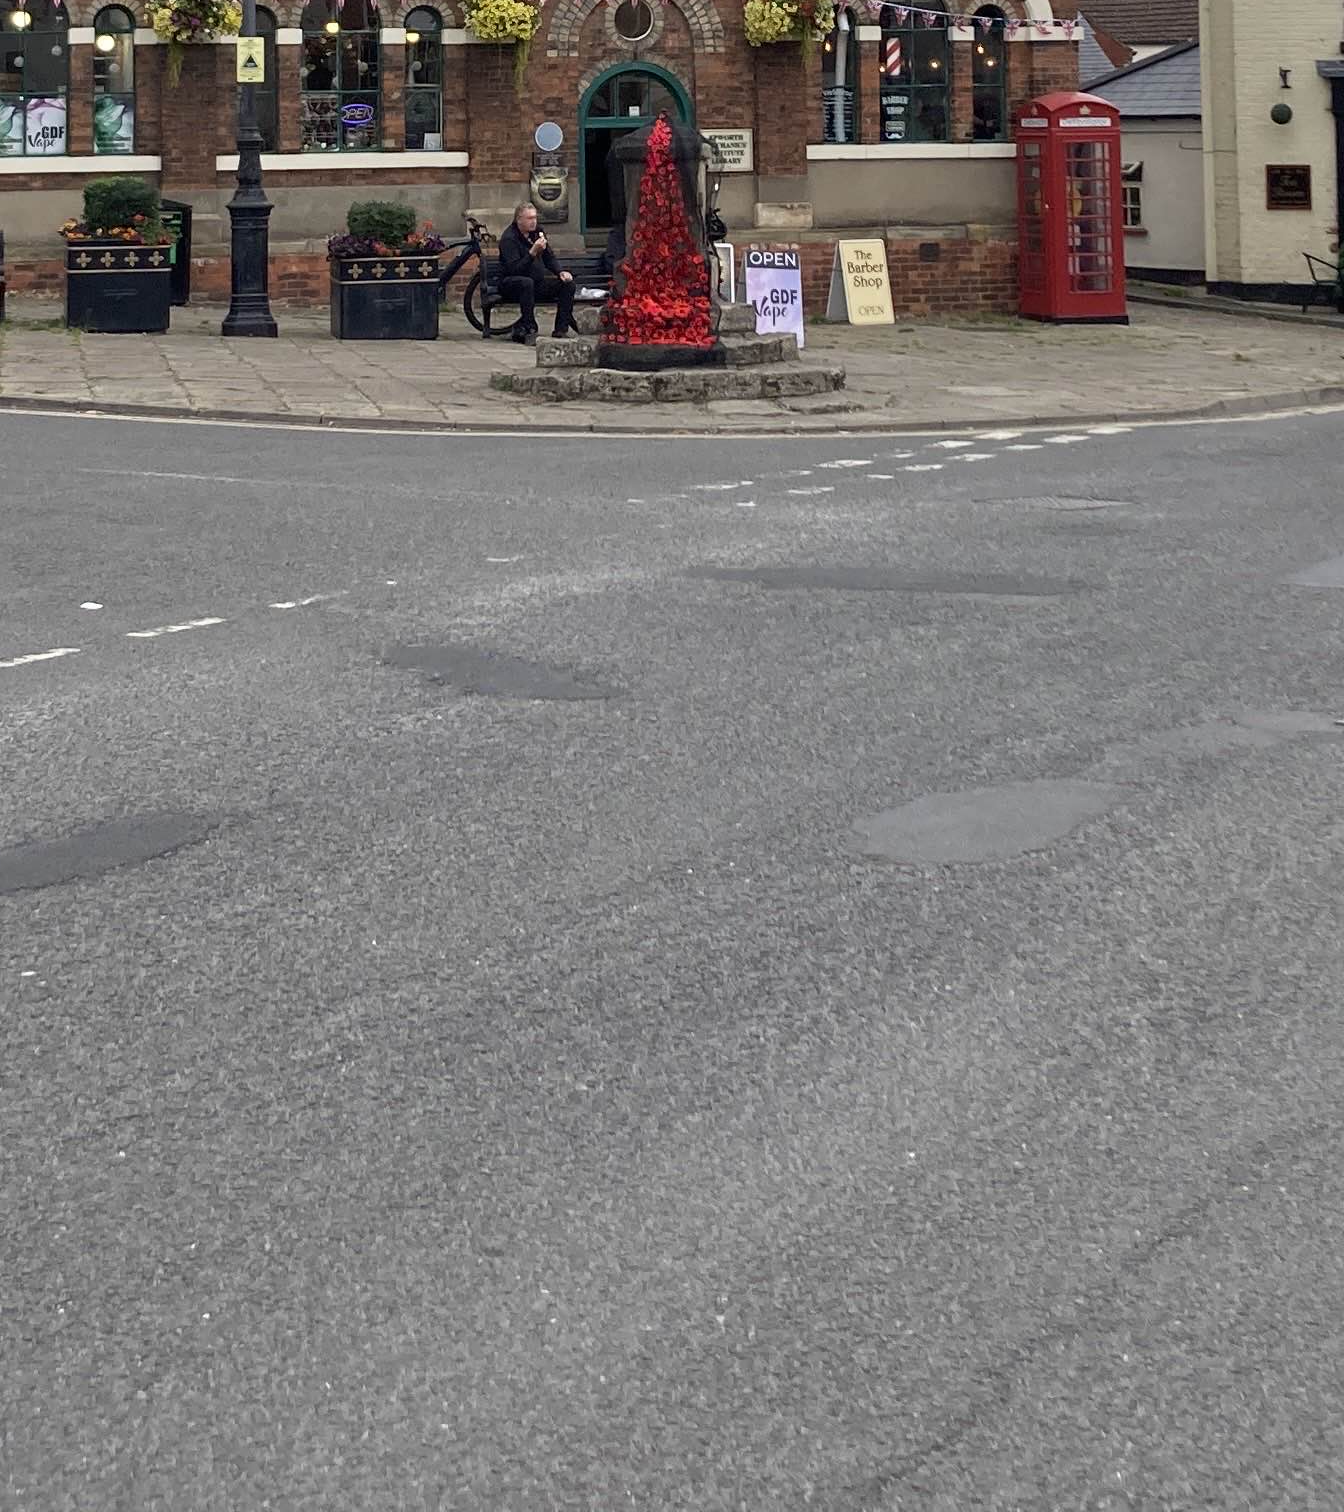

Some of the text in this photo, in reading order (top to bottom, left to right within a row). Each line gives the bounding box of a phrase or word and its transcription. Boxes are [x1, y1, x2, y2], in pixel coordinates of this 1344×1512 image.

[41, 126, 65, 139] GDF
[28, 132, 56, 153] Vape
[749, 251, 797, 267] OPEN
[854, 250, 872, 260] The
[847, 262, 884, 274] Barber
[854, 276, 883, 290] Shop
[770, 288, 798, 305] GDF
[752, 295, 789, 326] Vape
[858, 305, 885, 316] OPEN
